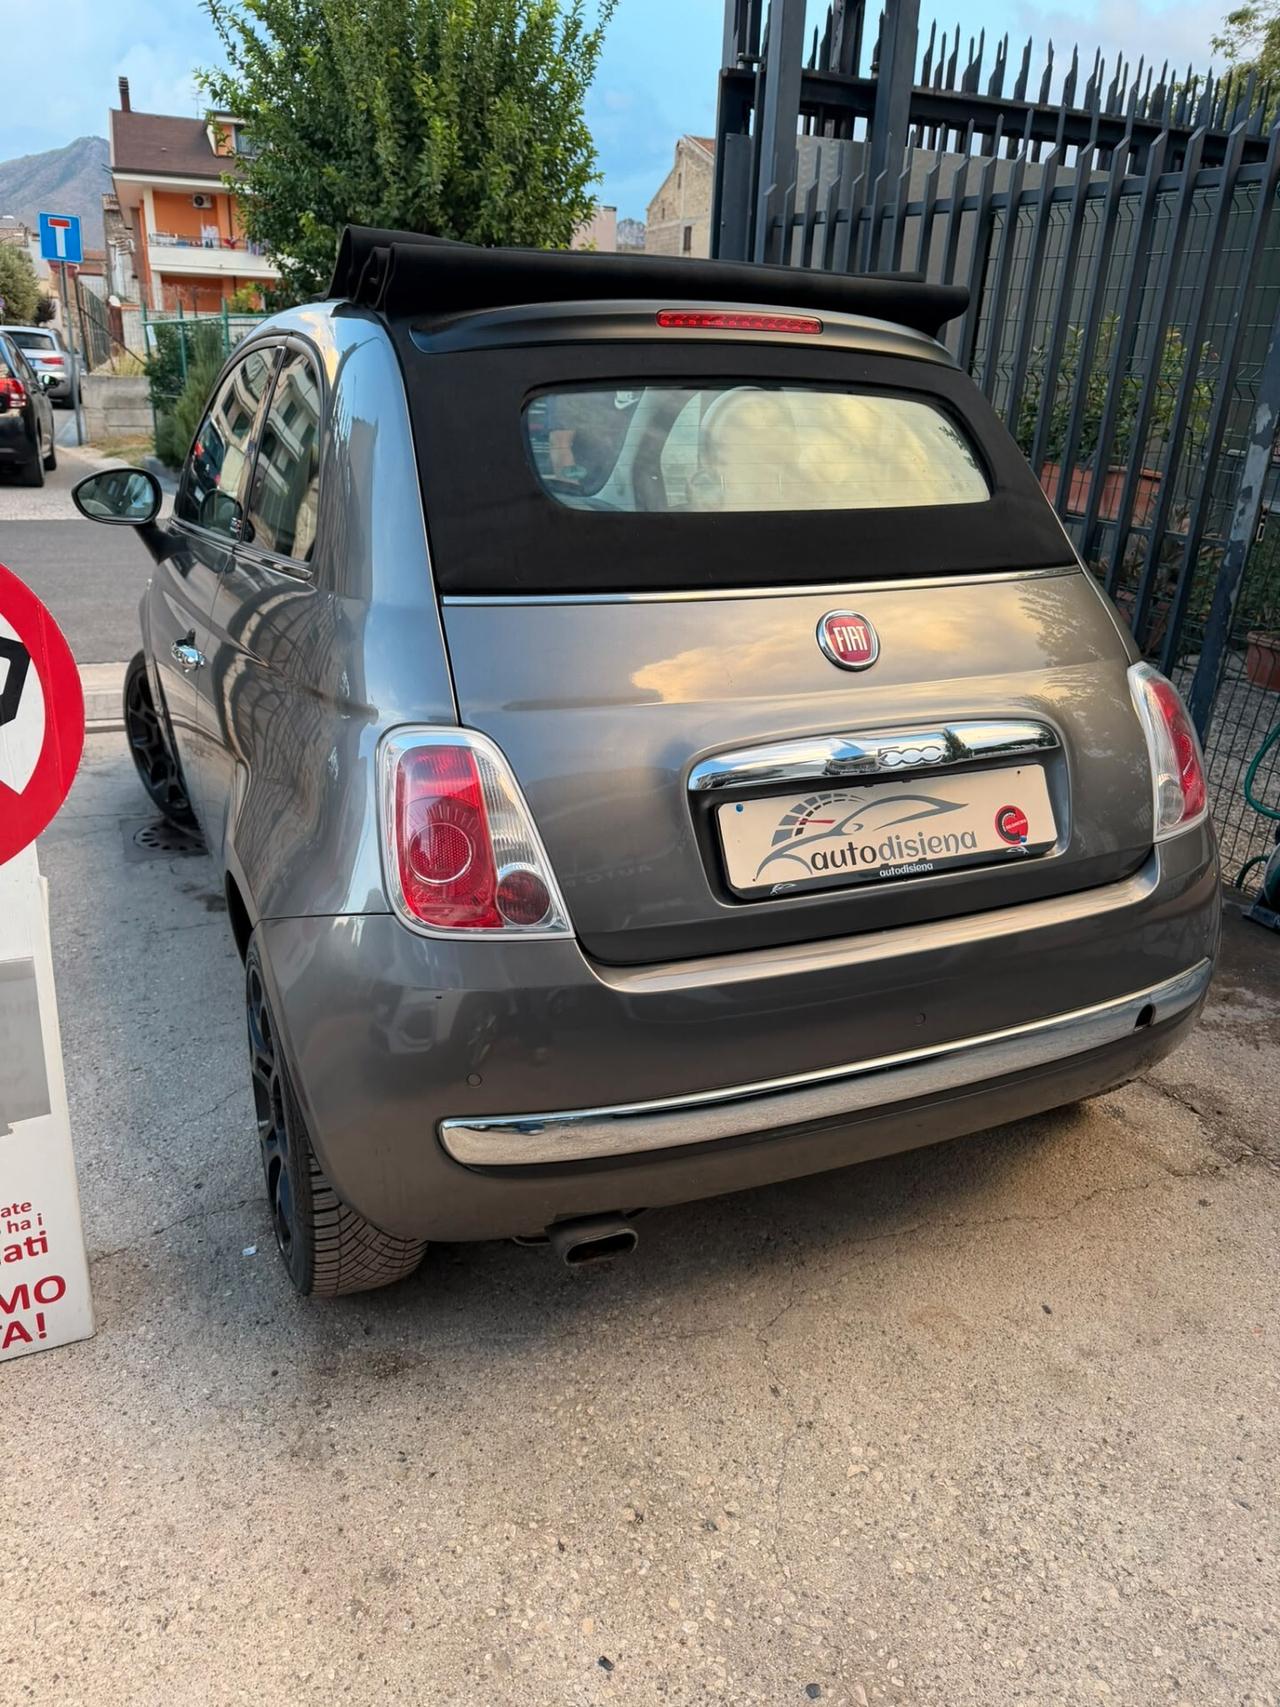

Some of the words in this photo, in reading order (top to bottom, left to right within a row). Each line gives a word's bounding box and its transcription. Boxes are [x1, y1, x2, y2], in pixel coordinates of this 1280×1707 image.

[832, 625, 868, 653] FIAT
[877, 745, 943, 767] 500
[811, 831, 977, 871] autodisiena
[879, 862, 934, 878] autodisiena
[7, 1219, 31, 1234] ha
[37, 1213, 43, 1226] i
[0, 1230, 49, 1264] ati
[0, 1312, 47, 1349] A!
